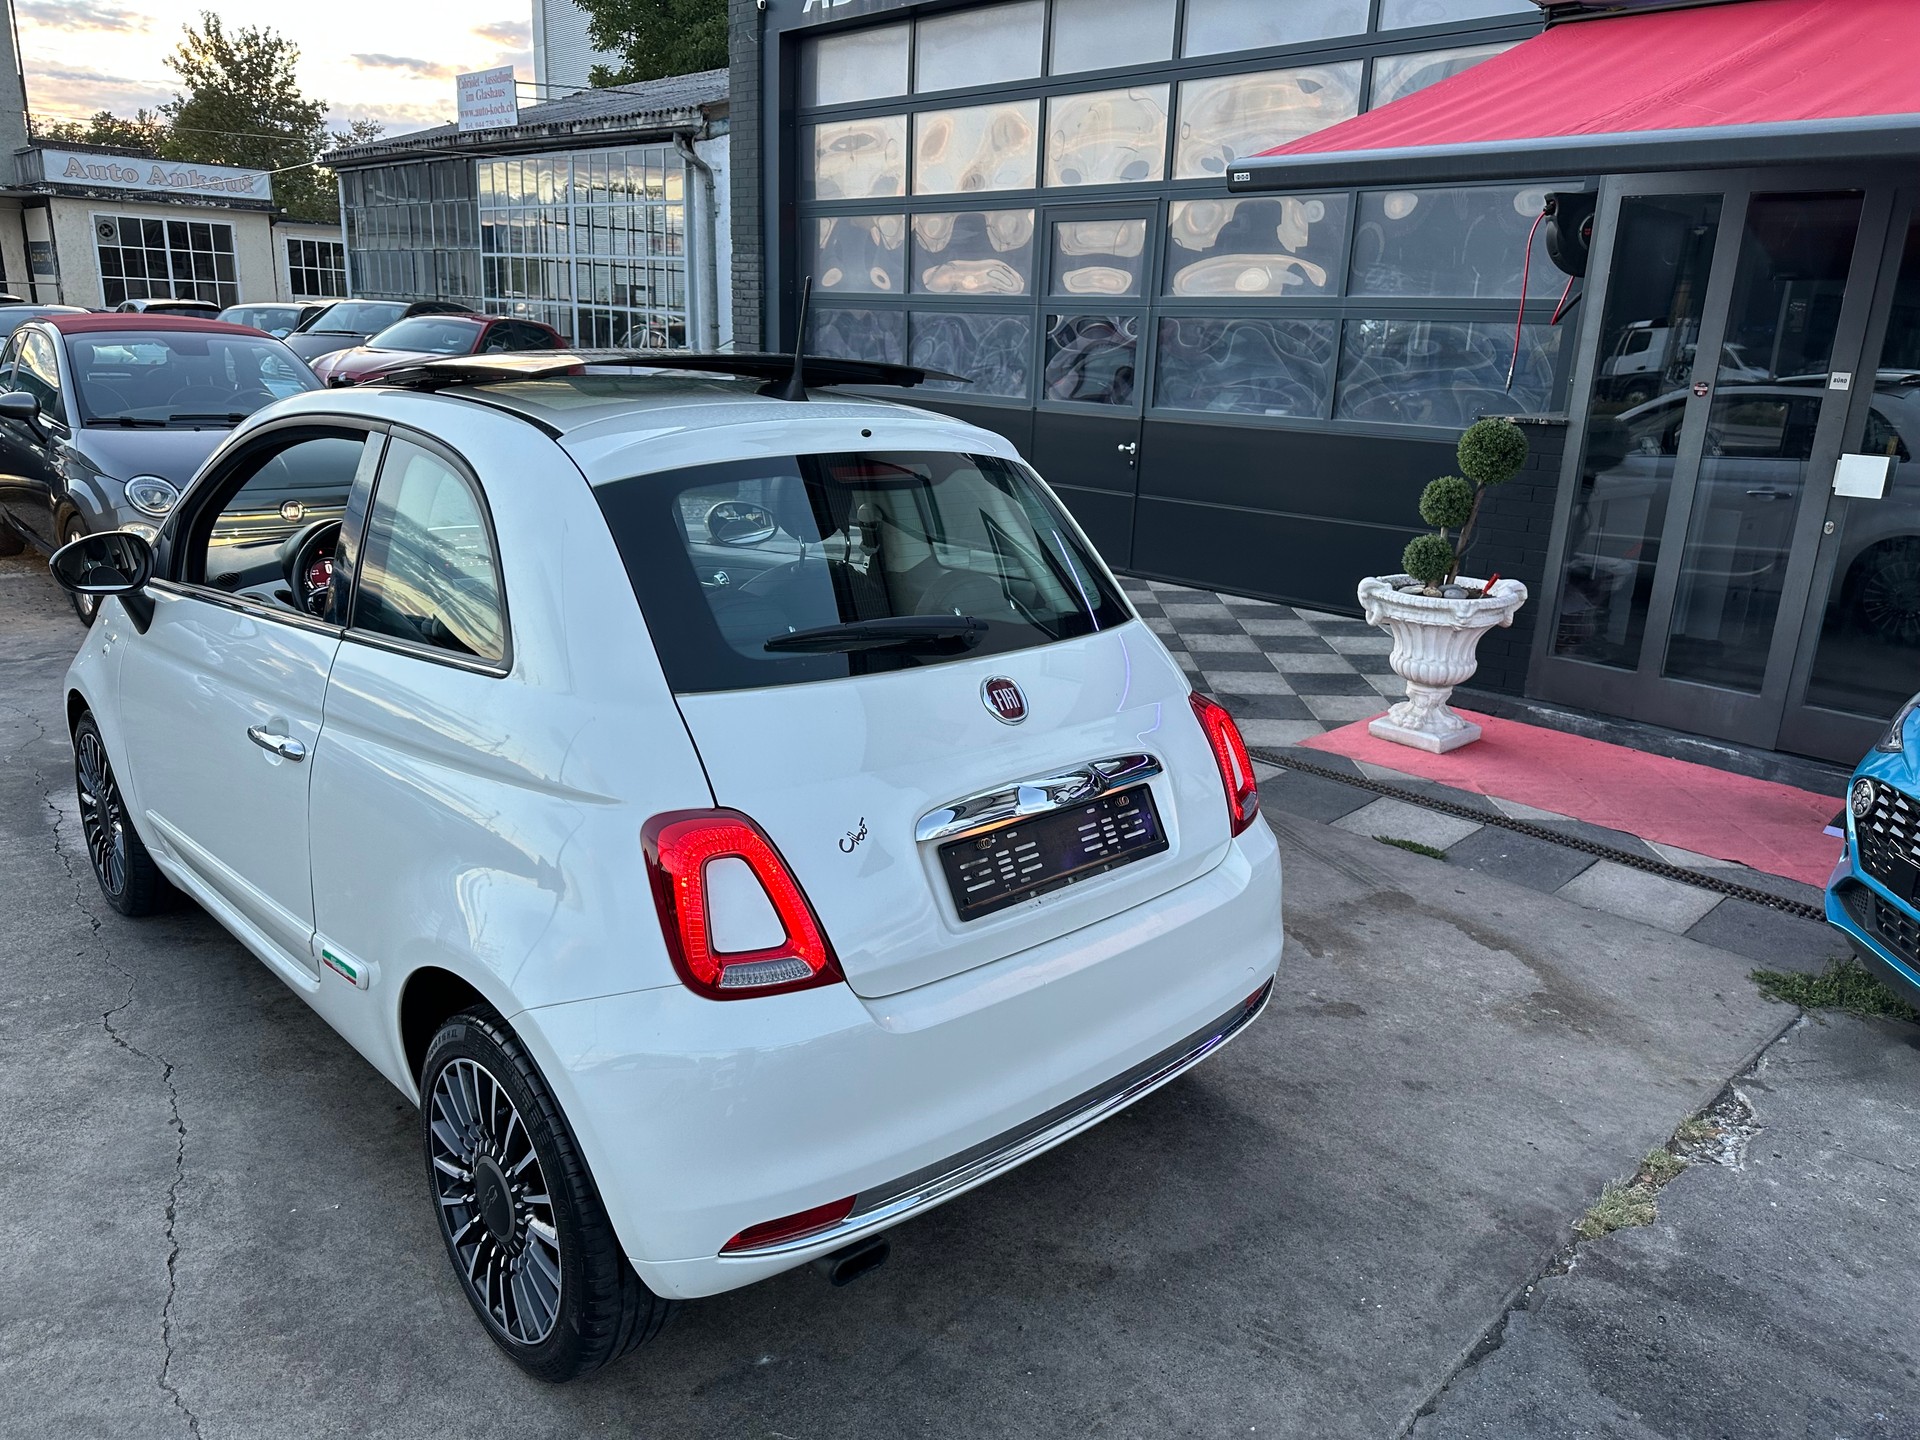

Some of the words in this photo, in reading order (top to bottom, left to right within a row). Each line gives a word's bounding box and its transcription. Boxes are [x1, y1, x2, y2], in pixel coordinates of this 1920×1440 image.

[465, 91, 474, 102] im
[475, 87, 506, 101] Glashaus
[459, 101, 515, 118] www.auto-koch.ch
[63, 156, 139, 183] Auto
[146, 165, 254, 194] Ankauf
[992, 687, 1021, 711] FIAT
